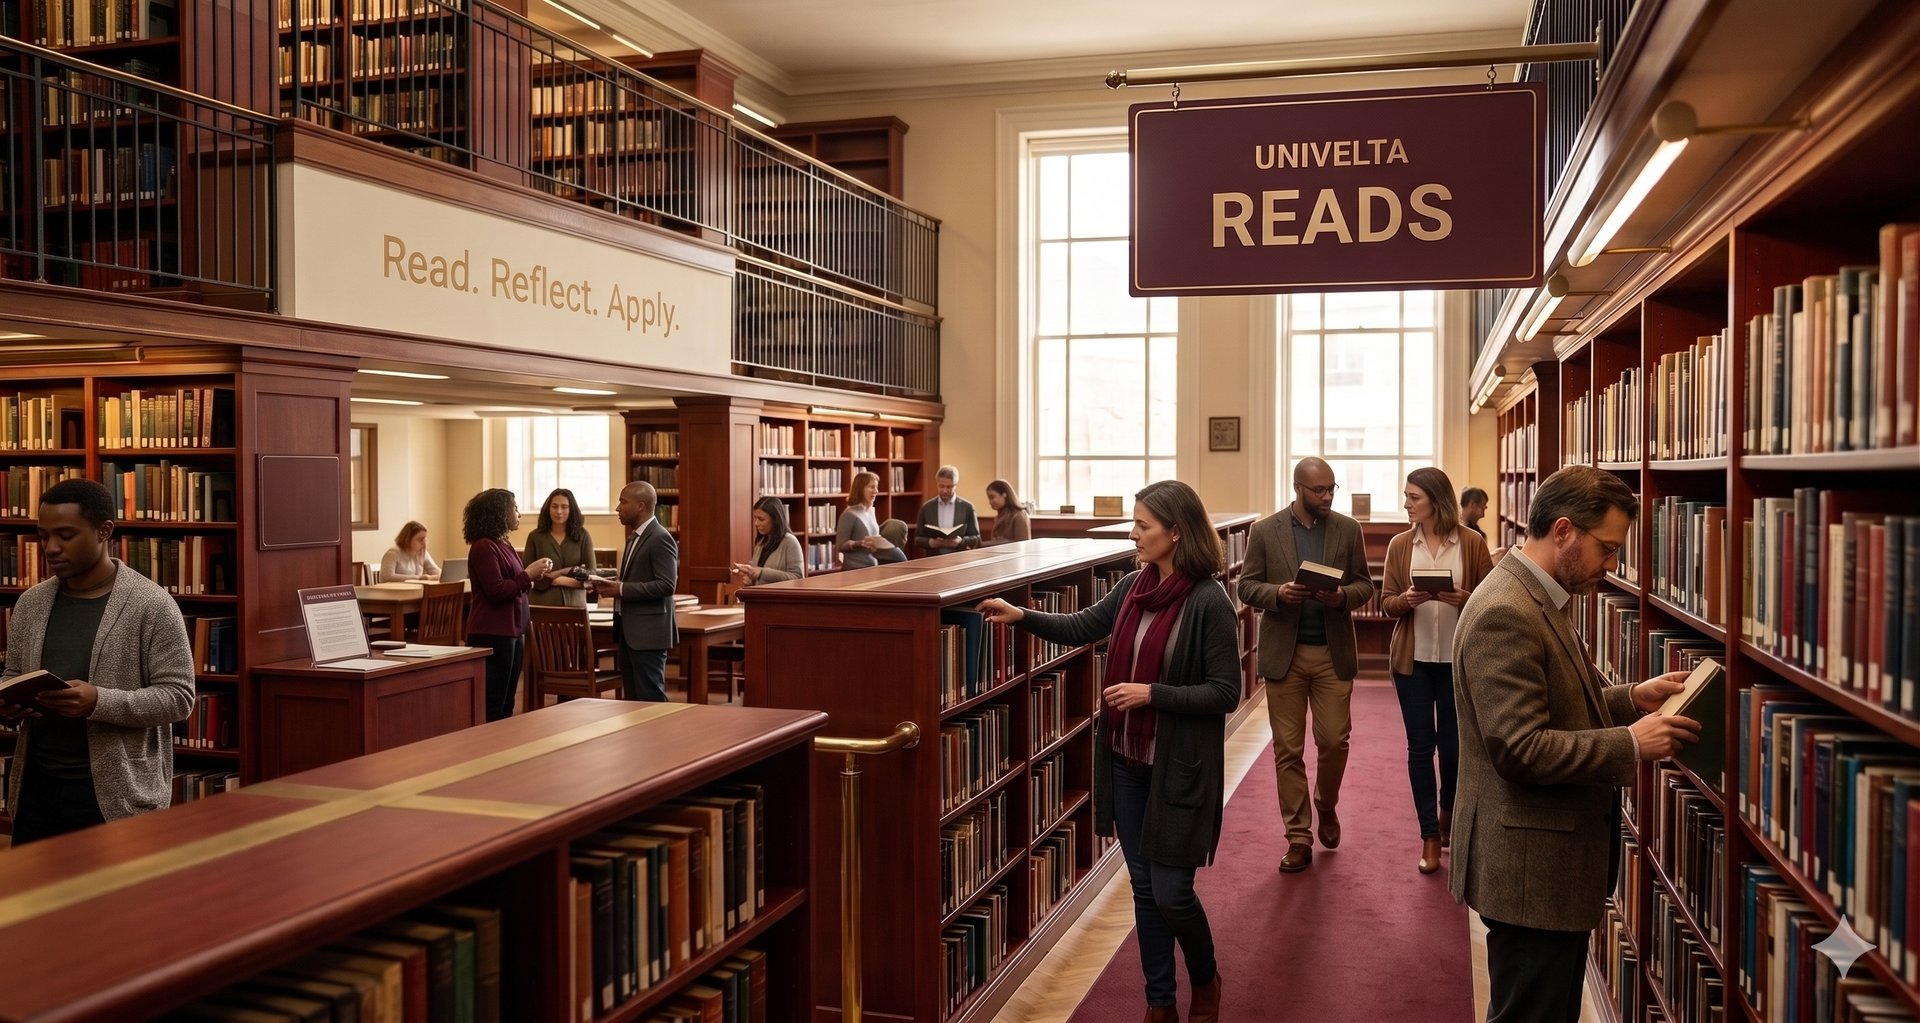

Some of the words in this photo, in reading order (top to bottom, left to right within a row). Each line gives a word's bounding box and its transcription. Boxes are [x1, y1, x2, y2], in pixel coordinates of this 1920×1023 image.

[1255, 138, 1409, 170] UNIVELTA
[1212, 183, 1453, 248] READS
[383, 234, 479, 294] Read.
[491, 257, 598, 316] Reflect.
[607, 283, 680, 338] Apply.
